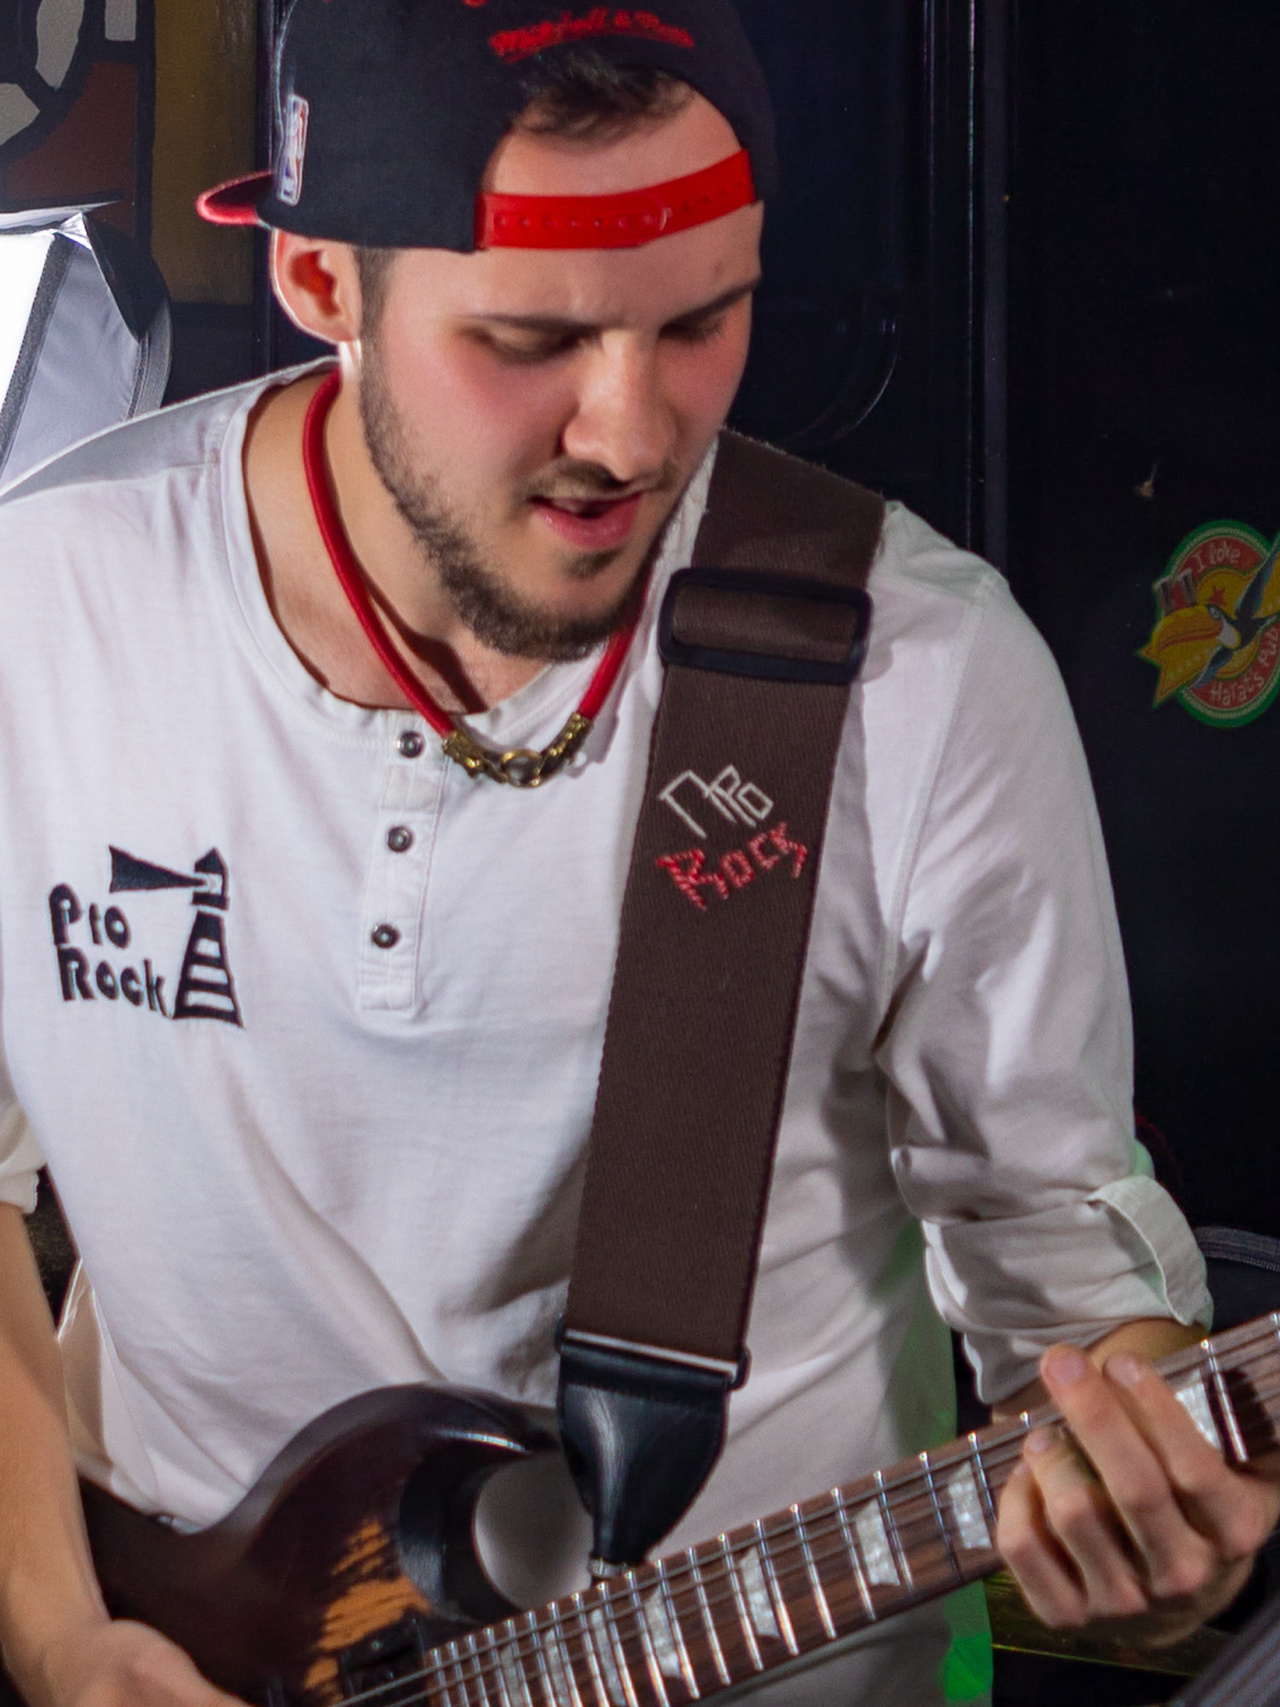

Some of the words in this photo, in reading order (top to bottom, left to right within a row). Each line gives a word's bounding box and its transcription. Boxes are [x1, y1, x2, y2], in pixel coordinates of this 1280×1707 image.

[1193, 549, 1207, 573] I
[1210, 540, 1240, 565] love
[57, 947, 168, 1017] Rock
